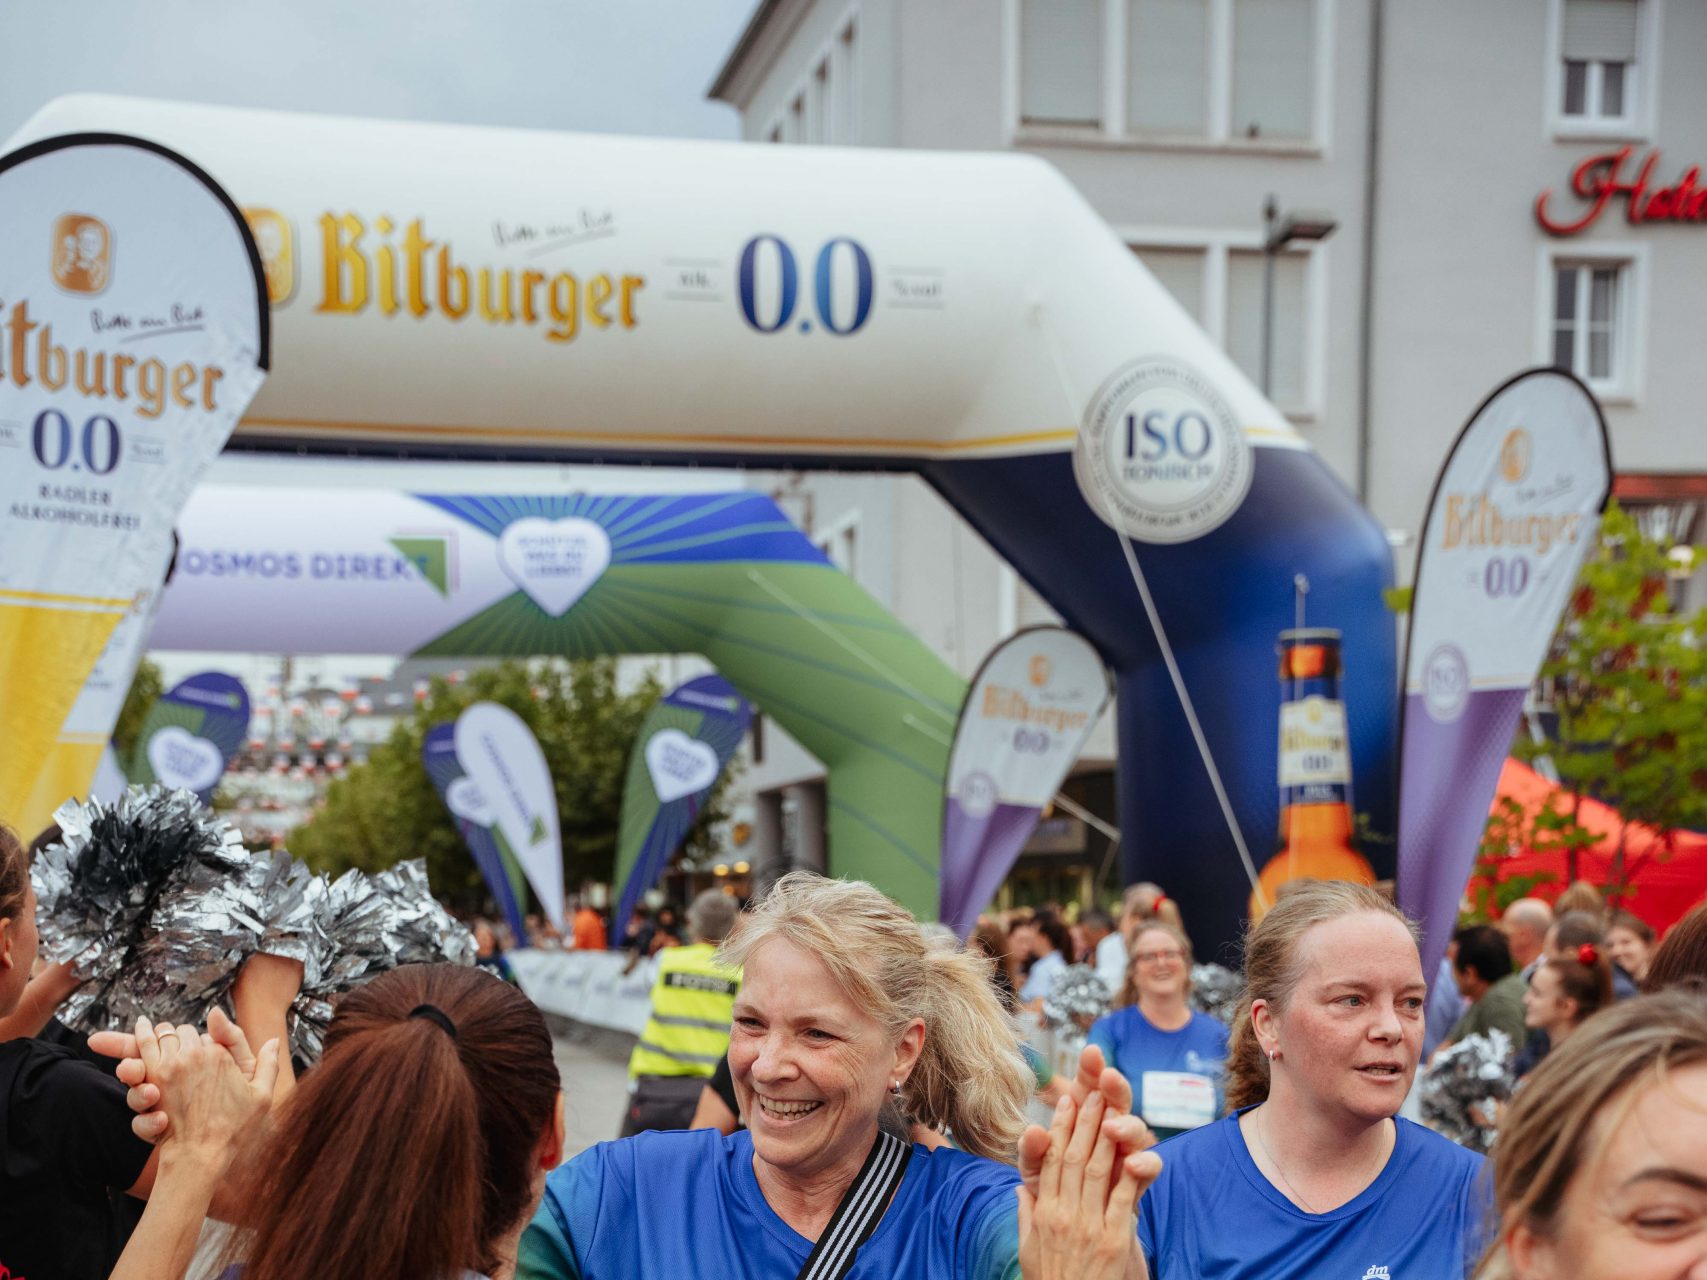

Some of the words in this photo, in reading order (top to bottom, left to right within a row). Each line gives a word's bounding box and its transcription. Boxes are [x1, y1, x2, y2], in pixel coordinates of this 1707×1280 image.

[313, 211, 646, 343] Bitburger
[736, 233, 876, 336] 0.0
[0, 299, 225, 419] tburger
[32, 407, 122, 476] 0.0
[1125, 409, 1213, 462] ISO
[183, 548, 302, 579] OSMOS
[1367, 1265, 1388, 1275] dm
